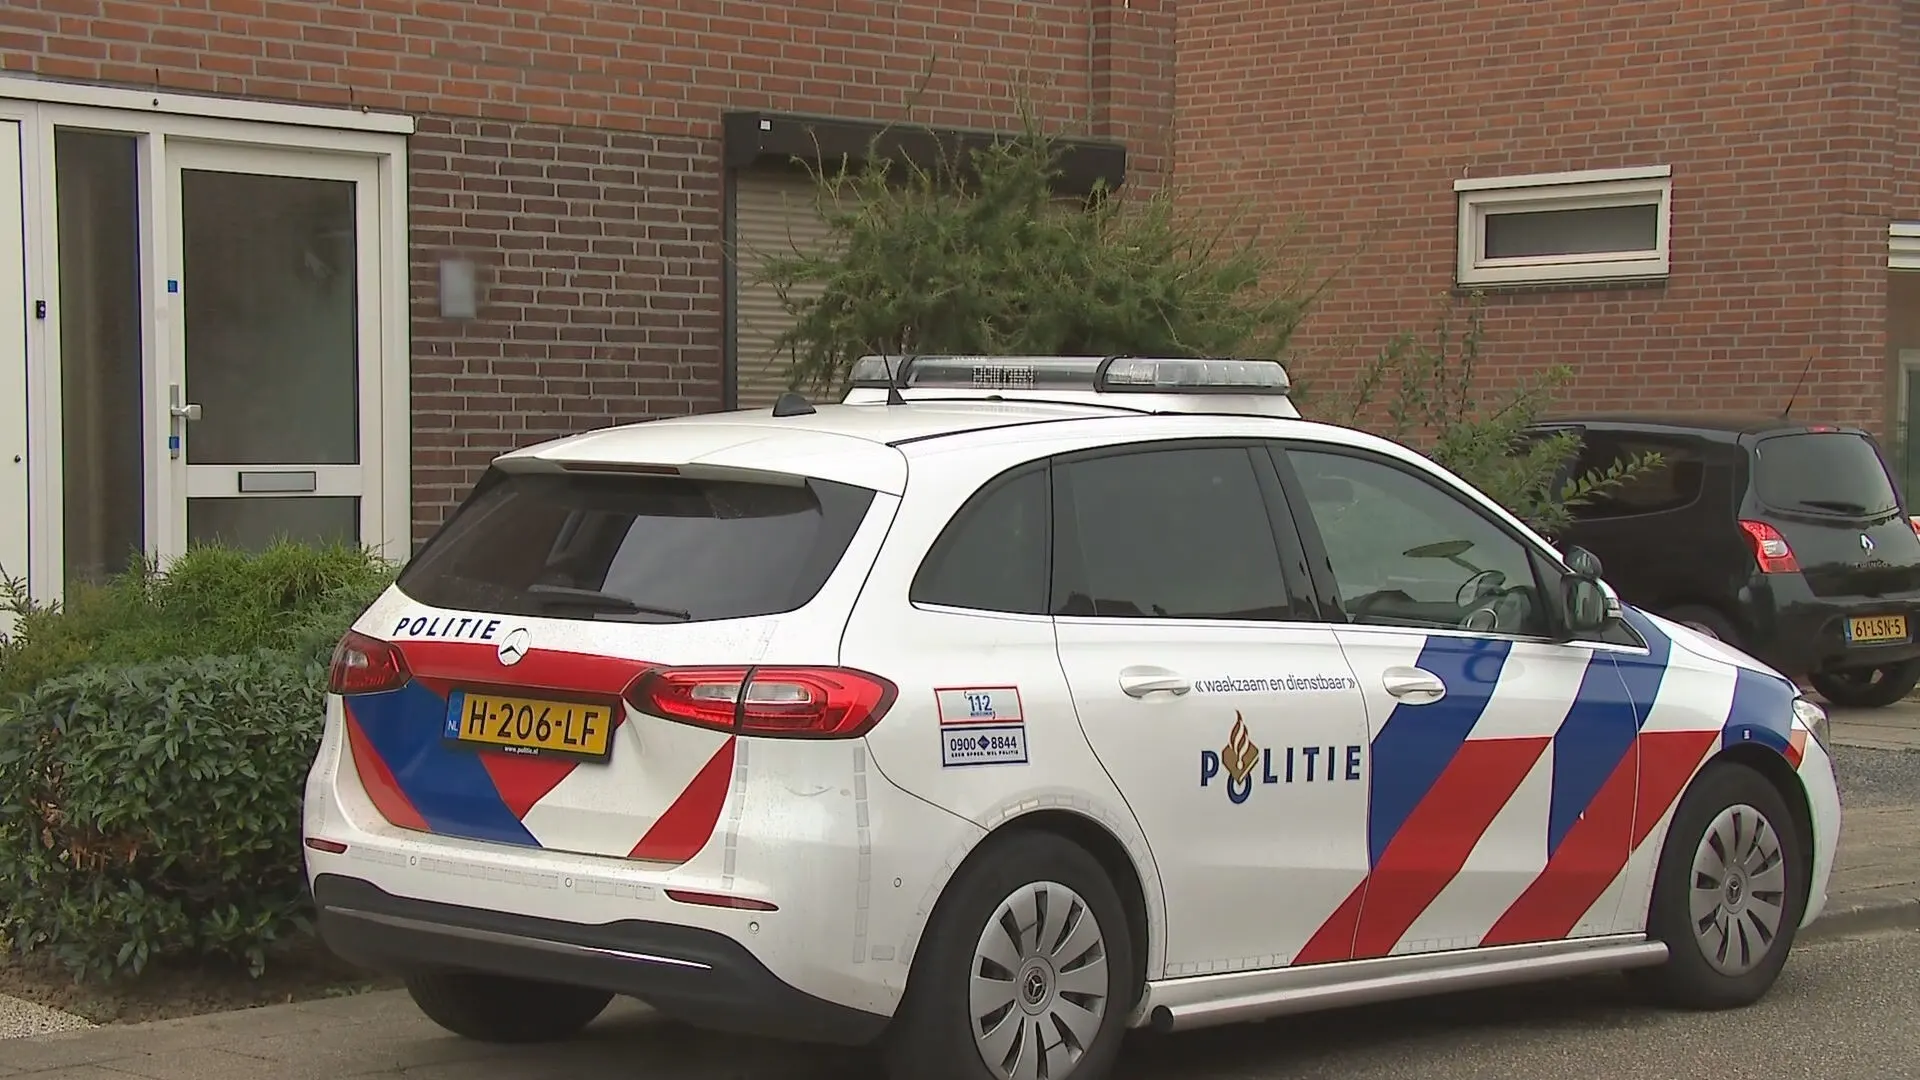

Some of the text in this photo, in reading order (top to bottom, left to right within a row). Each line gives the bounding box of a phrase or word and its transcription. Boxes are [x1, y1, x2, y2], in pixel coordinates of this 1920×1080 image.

[392, 616, 501, 640] POLITIE
[1855, 619, 1901, 637] 61-LSN-5
[1270, 677, 1285, 691] en
[447, 720, 459, 732] NL
[469, 700, 599, 746] H-206-LF
[950, 736, 1017, 751] 0900 8844
[1200, 745, 1361, 804] POLITIE
